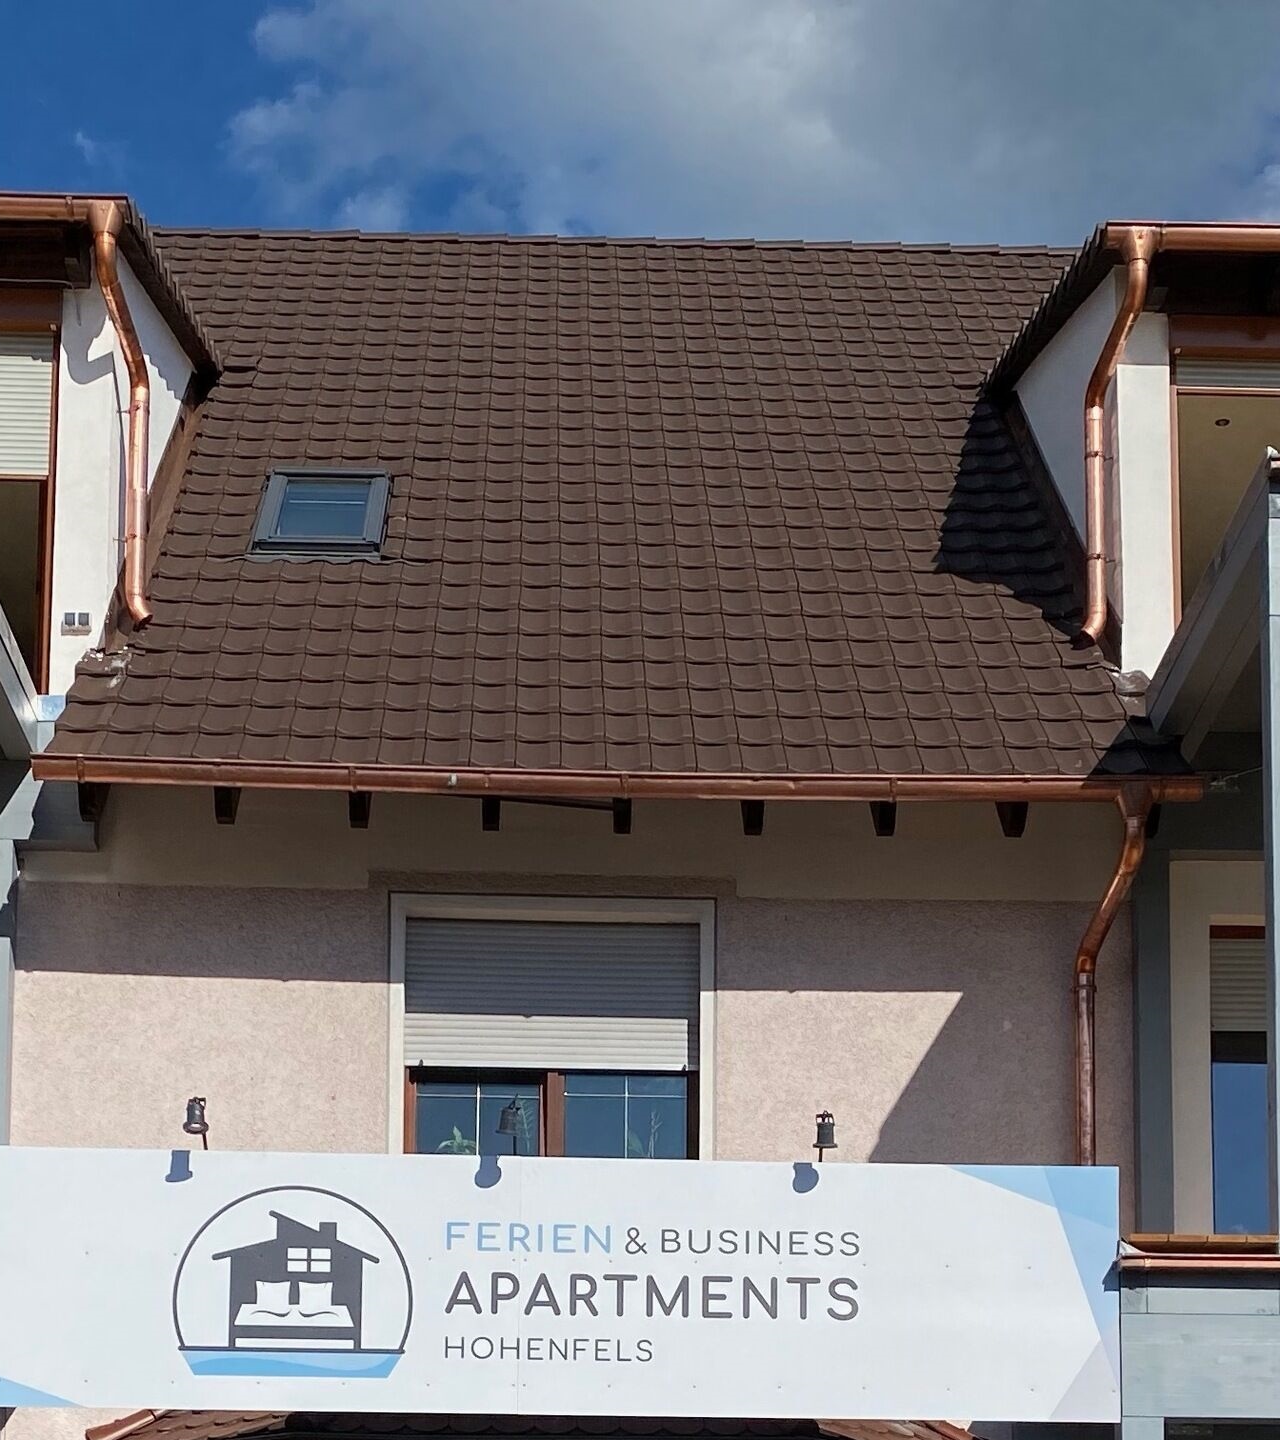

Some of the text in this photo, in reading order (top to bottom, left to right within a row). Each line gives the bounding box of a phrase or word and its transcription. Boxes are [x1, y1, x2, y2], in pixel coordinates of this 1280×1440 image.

[445, 1221, 861, 1258] FERIEN & BUSINESS
[444, 1270, 860, 1322] APARTMENTS
[444, 1335, 654, 1364] HOHENFELS
